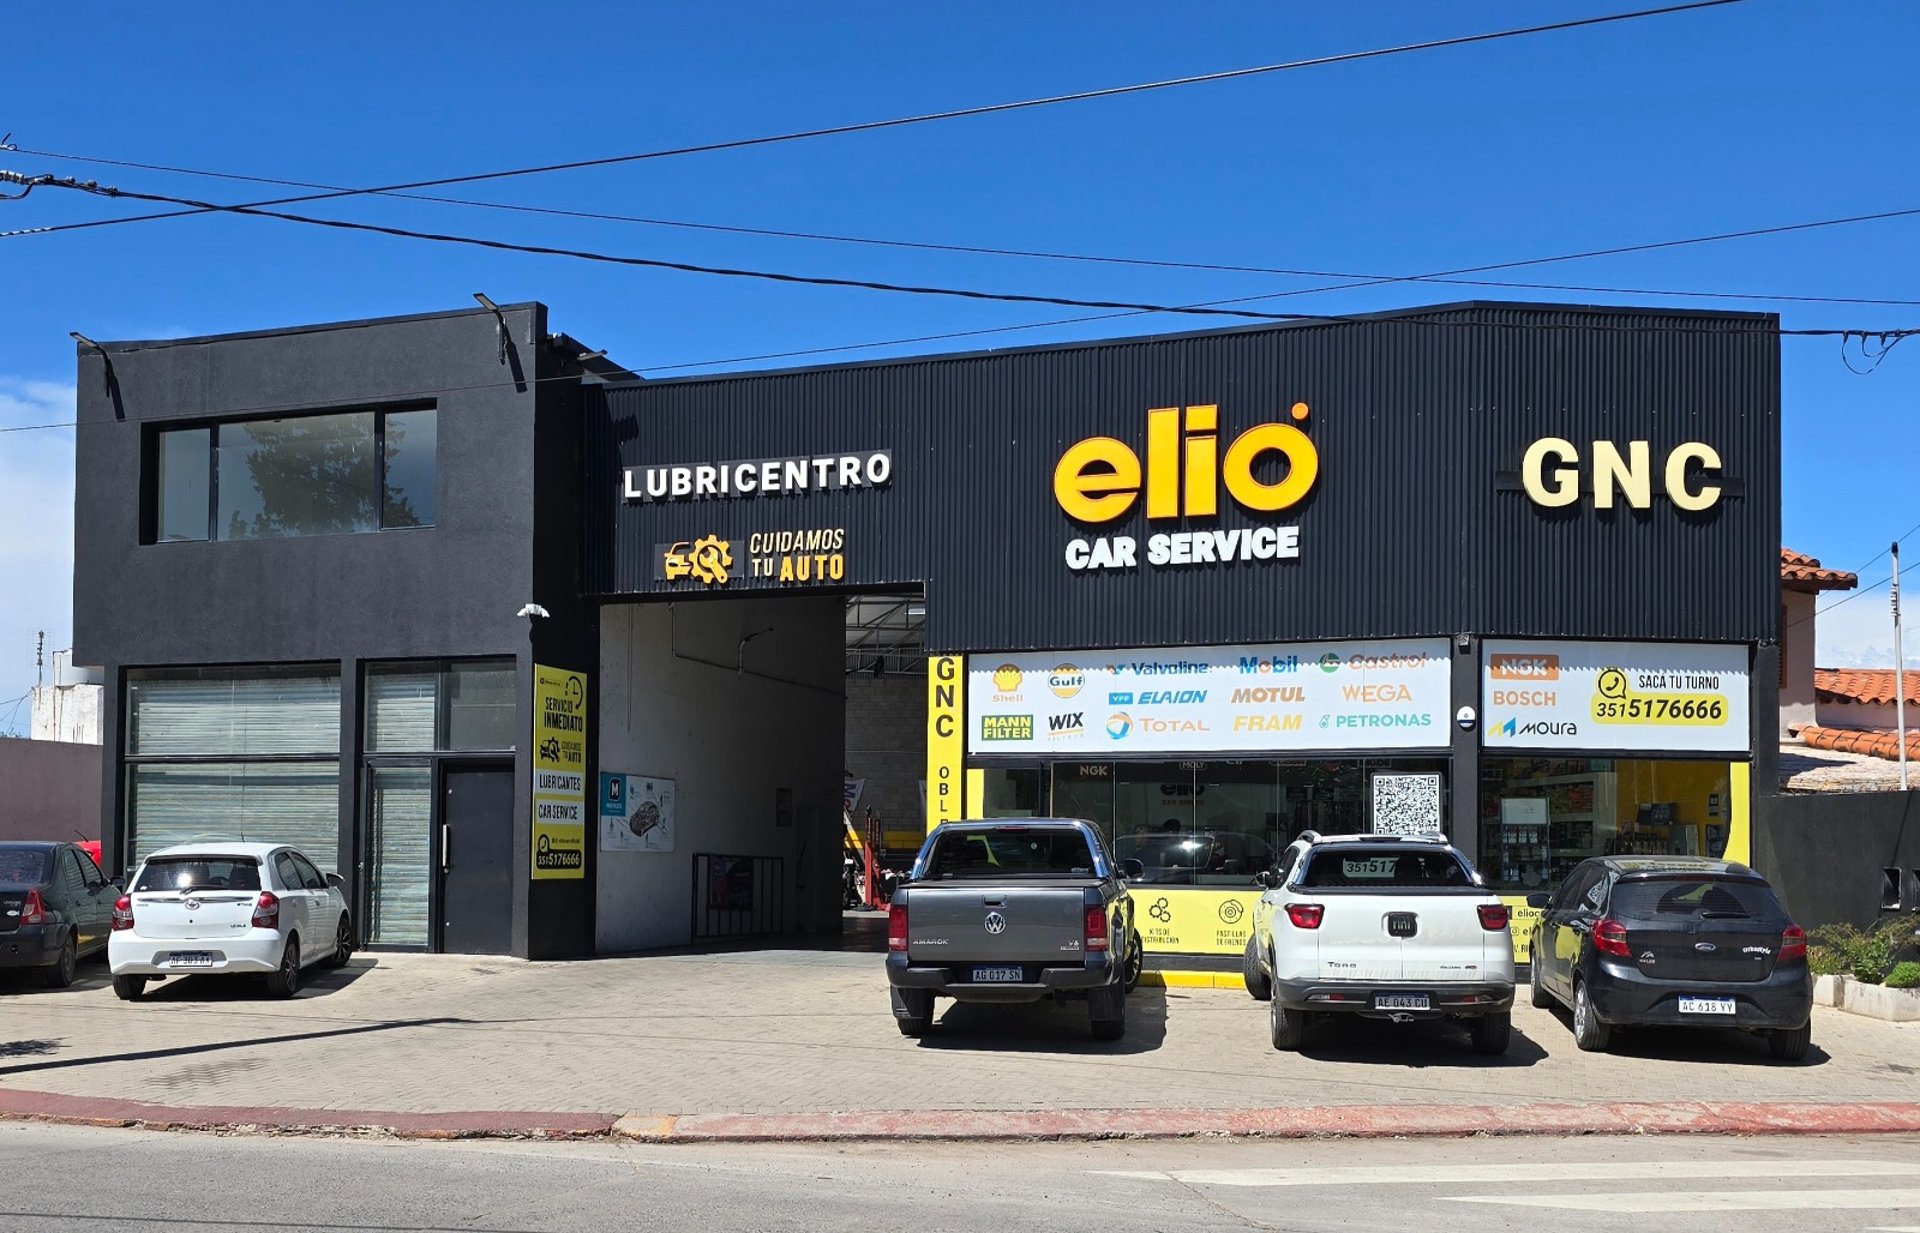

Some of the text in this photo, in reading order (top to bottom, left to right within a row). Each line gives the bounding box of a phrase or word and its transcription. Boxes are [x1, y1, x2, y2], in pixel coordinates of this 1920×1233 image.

[1054, 403, 1318, 523] elio
[624, 453, 890, 498] LUBRICENTRO
[1522, 437, 1722, 511] GNC
[750, 528, 844, 554] CUIDAMOS
[1065, 525, 1300, 570] CAR SERVICE
[752, 554, 844, 581] TU AUTO
[1131, 661, 1210, 676] Valvoline
[1240, 656, 1298, 674] Mobil
[1349, 652, 1427, 670] Castrol
[1501, 658, 1548, 677] NGK
[1049, 675, 1083, 687] Gulf
[1669, 675, 1682, 689] TU
[1685, 676, 1719, 690] TURNO
[936, 657, 954, 738] GNC
[992, 694, 1024, 703] Shell
[1138, 690, 1208, 705] ELAION
[1231, 687, 1305, 704] MOTUL
[1342, 683, 1413, 702] WEGA
[1493, 690, 1556, 707] BOSCH
[545, 697, 573, 713] SERVICIO
[1596, 699, 1722, 720] 3515176666
[544, 711, 583, 732] INMEDIATO
[984, 716, 1032, 728] MANN
[1048, 712, 1084, 731] WIX
[1233, 715, 1303, 732] FRAM
[1336, 713, 1432, 729] PETRONAS
[983, 727, 1031, 739] FILTER
[1080, 765, 1108, 776] NGK
[539, 774, 581, 791] LUBRICANTES
[538, 804, 578, 820] CAR SERVICE
[975, 970, 987, 980] AG
[989, 970, 1005, 980] 017
[1378, 998, 1389, 1007] AE
[1393, 998, 1412, 1007] 043
[1683, 1002, 1733, 1013] AC 618 YY
